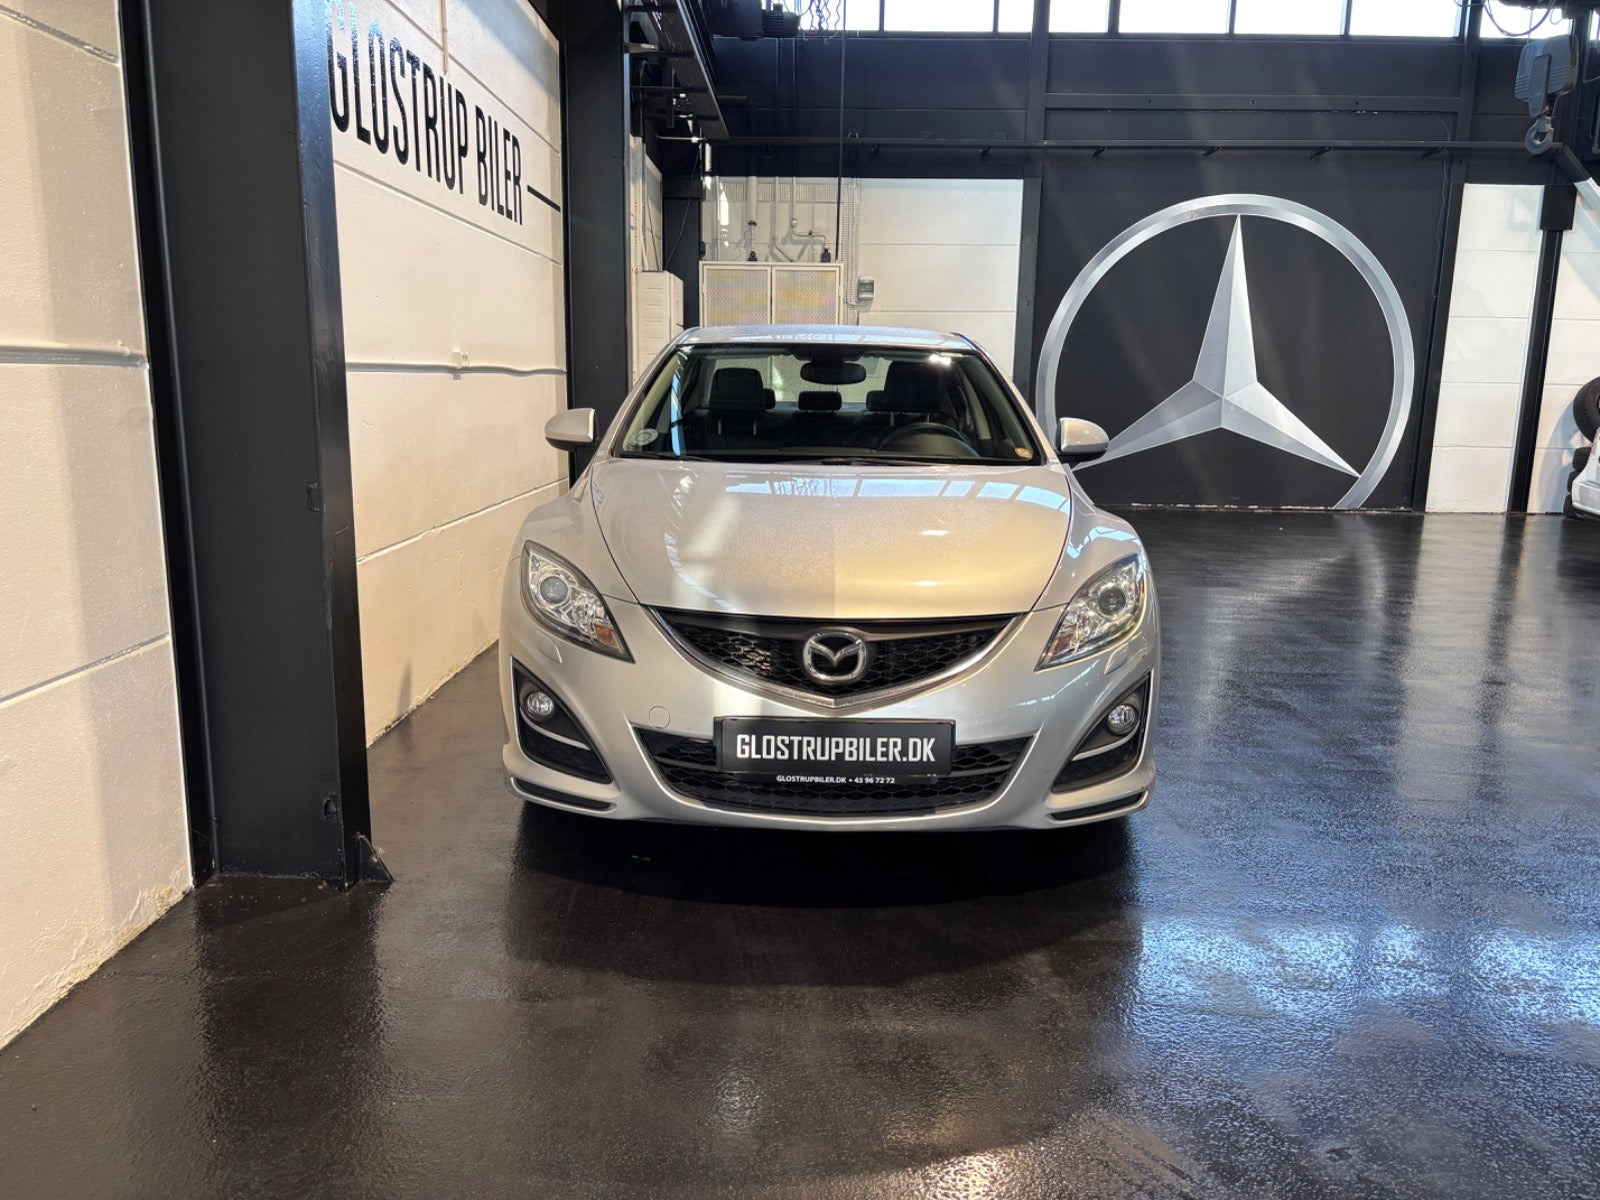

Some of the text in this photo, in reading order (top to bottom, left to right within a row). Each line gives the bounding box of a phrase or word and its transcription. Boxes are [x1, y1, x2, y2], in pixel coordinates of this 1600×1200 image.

[326, 0, 522, 225] GLOSTRUP BILER
[736, 734, 936, 762] GLOSTRUPBILER.DK
[776, 775, 847, 783] GLOSTRUPBILER.DK
